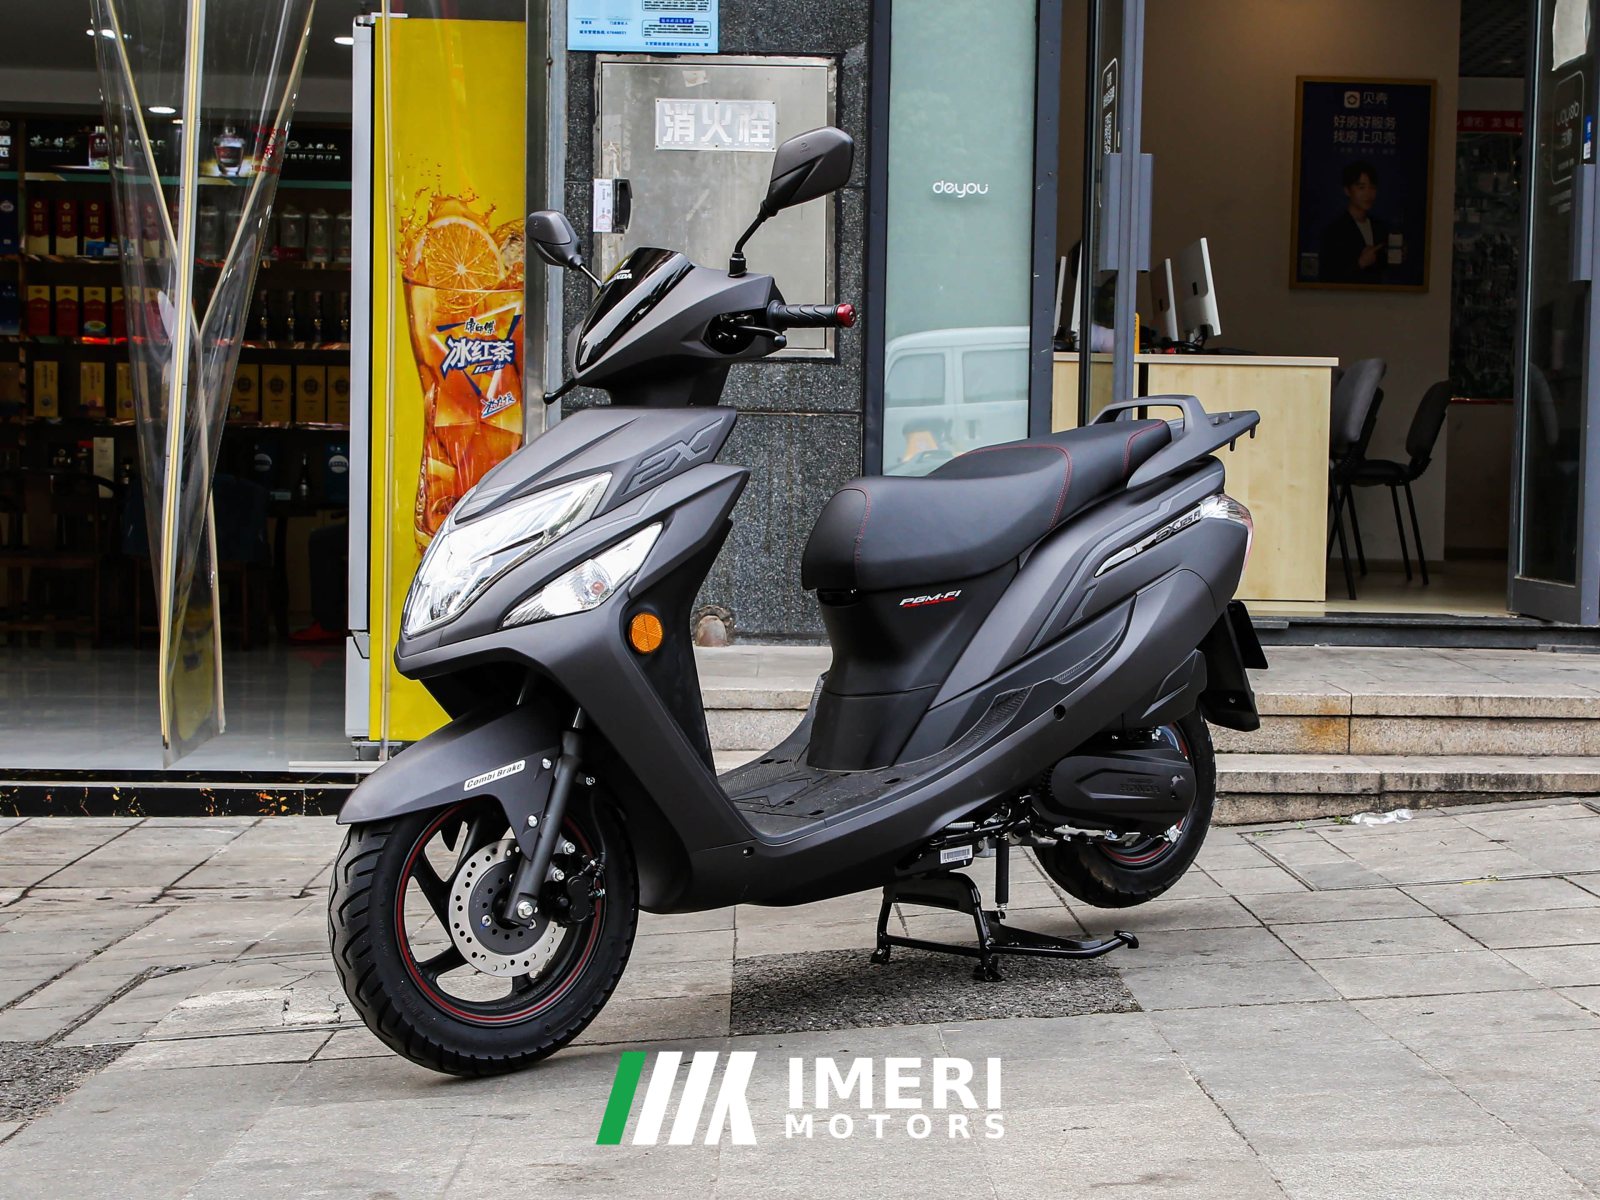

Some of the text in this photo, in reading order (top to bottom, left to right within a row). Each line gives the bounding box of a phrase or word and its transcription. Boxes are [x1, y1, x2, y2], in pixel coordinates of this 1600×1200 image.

[1362, 91, 1388, 105] 贝壳
[662, 103, 771, 143] 消火栓
[1333, 115, 1397, 129] 好房好服务
[1333, 130, 1397, 145] 找房上贝壳
[932, 180, 989, 198] deyou
[442, 337, 514, 374] 冰红茶
[473, 364, 495, 374] ICE
[466, 763, 523, 788] Combi Brake
